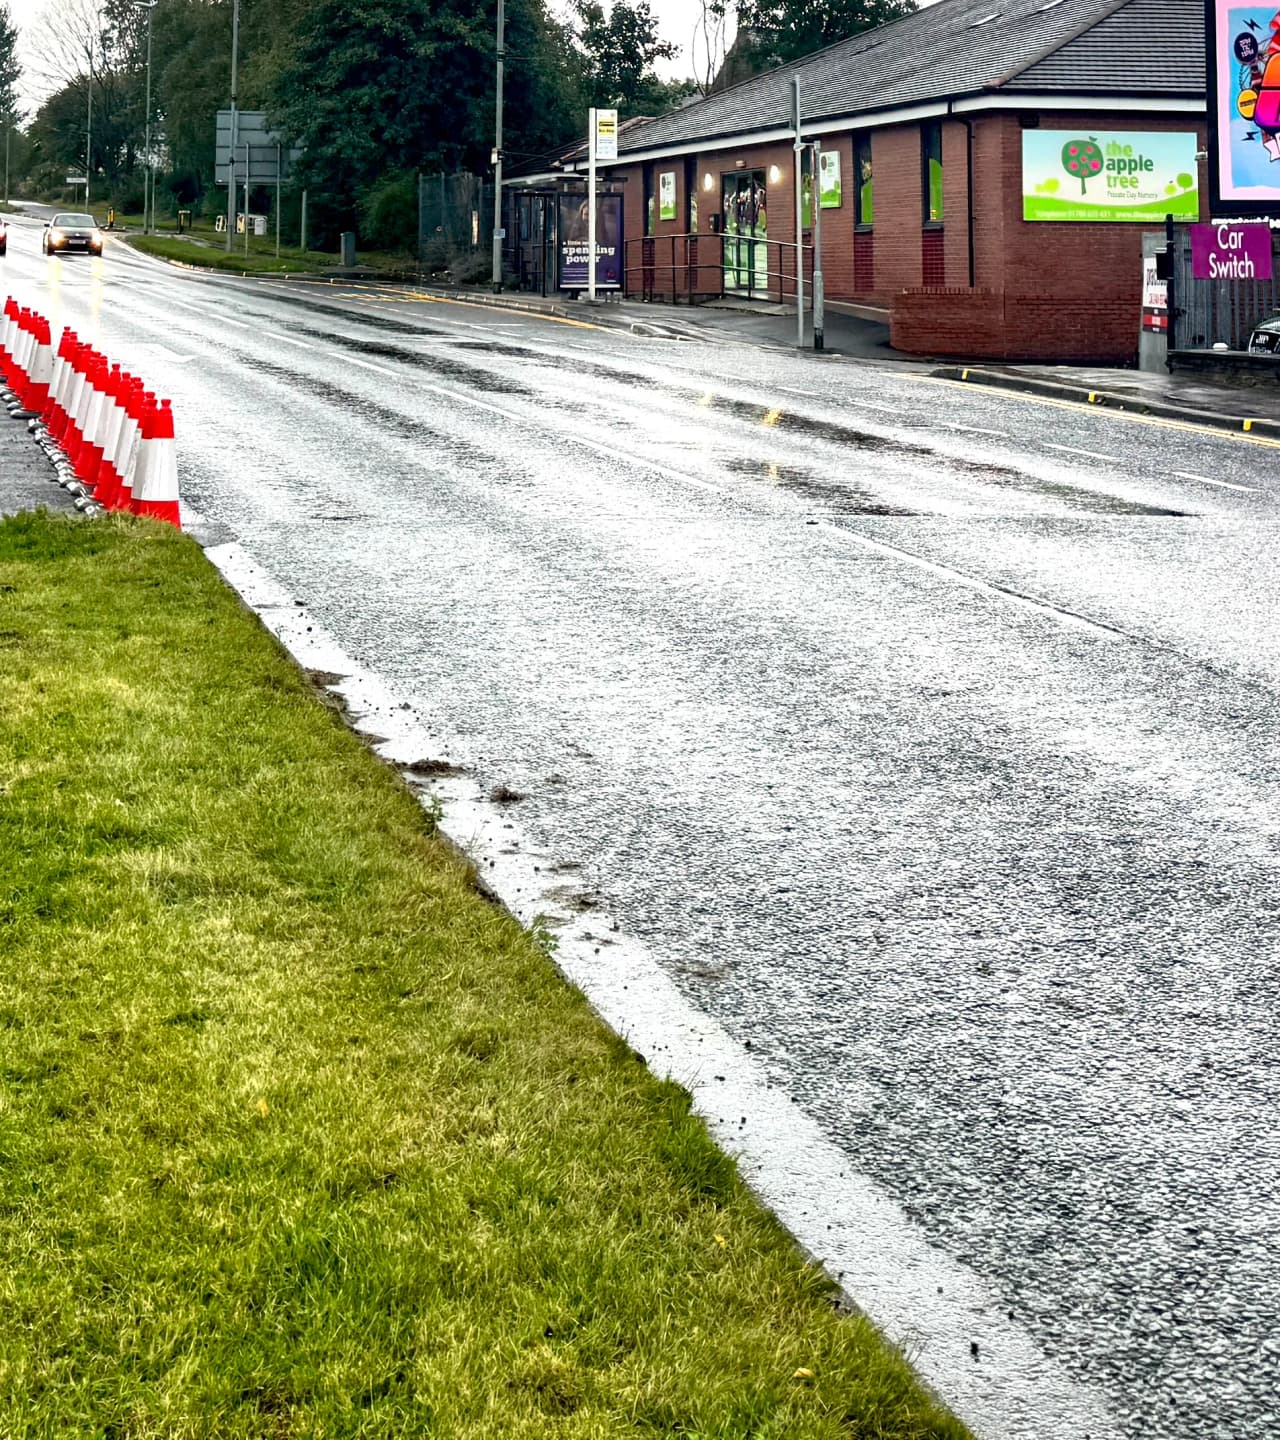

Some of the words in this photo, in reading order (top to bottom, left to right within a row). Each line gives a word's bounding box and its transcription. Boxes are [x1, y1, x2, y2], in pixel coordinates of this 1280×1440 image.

[1106, 140, 1133, 157] the
[1106, 155, 1154, 176] apple
[1106, 174, 1140, 189] tree
[1216, 224, 1244, 250] Car
[562, 245, 616, 256] spening
[566, 255, 601, 265] powr
[1208, 252, 1254, 279] Switch
